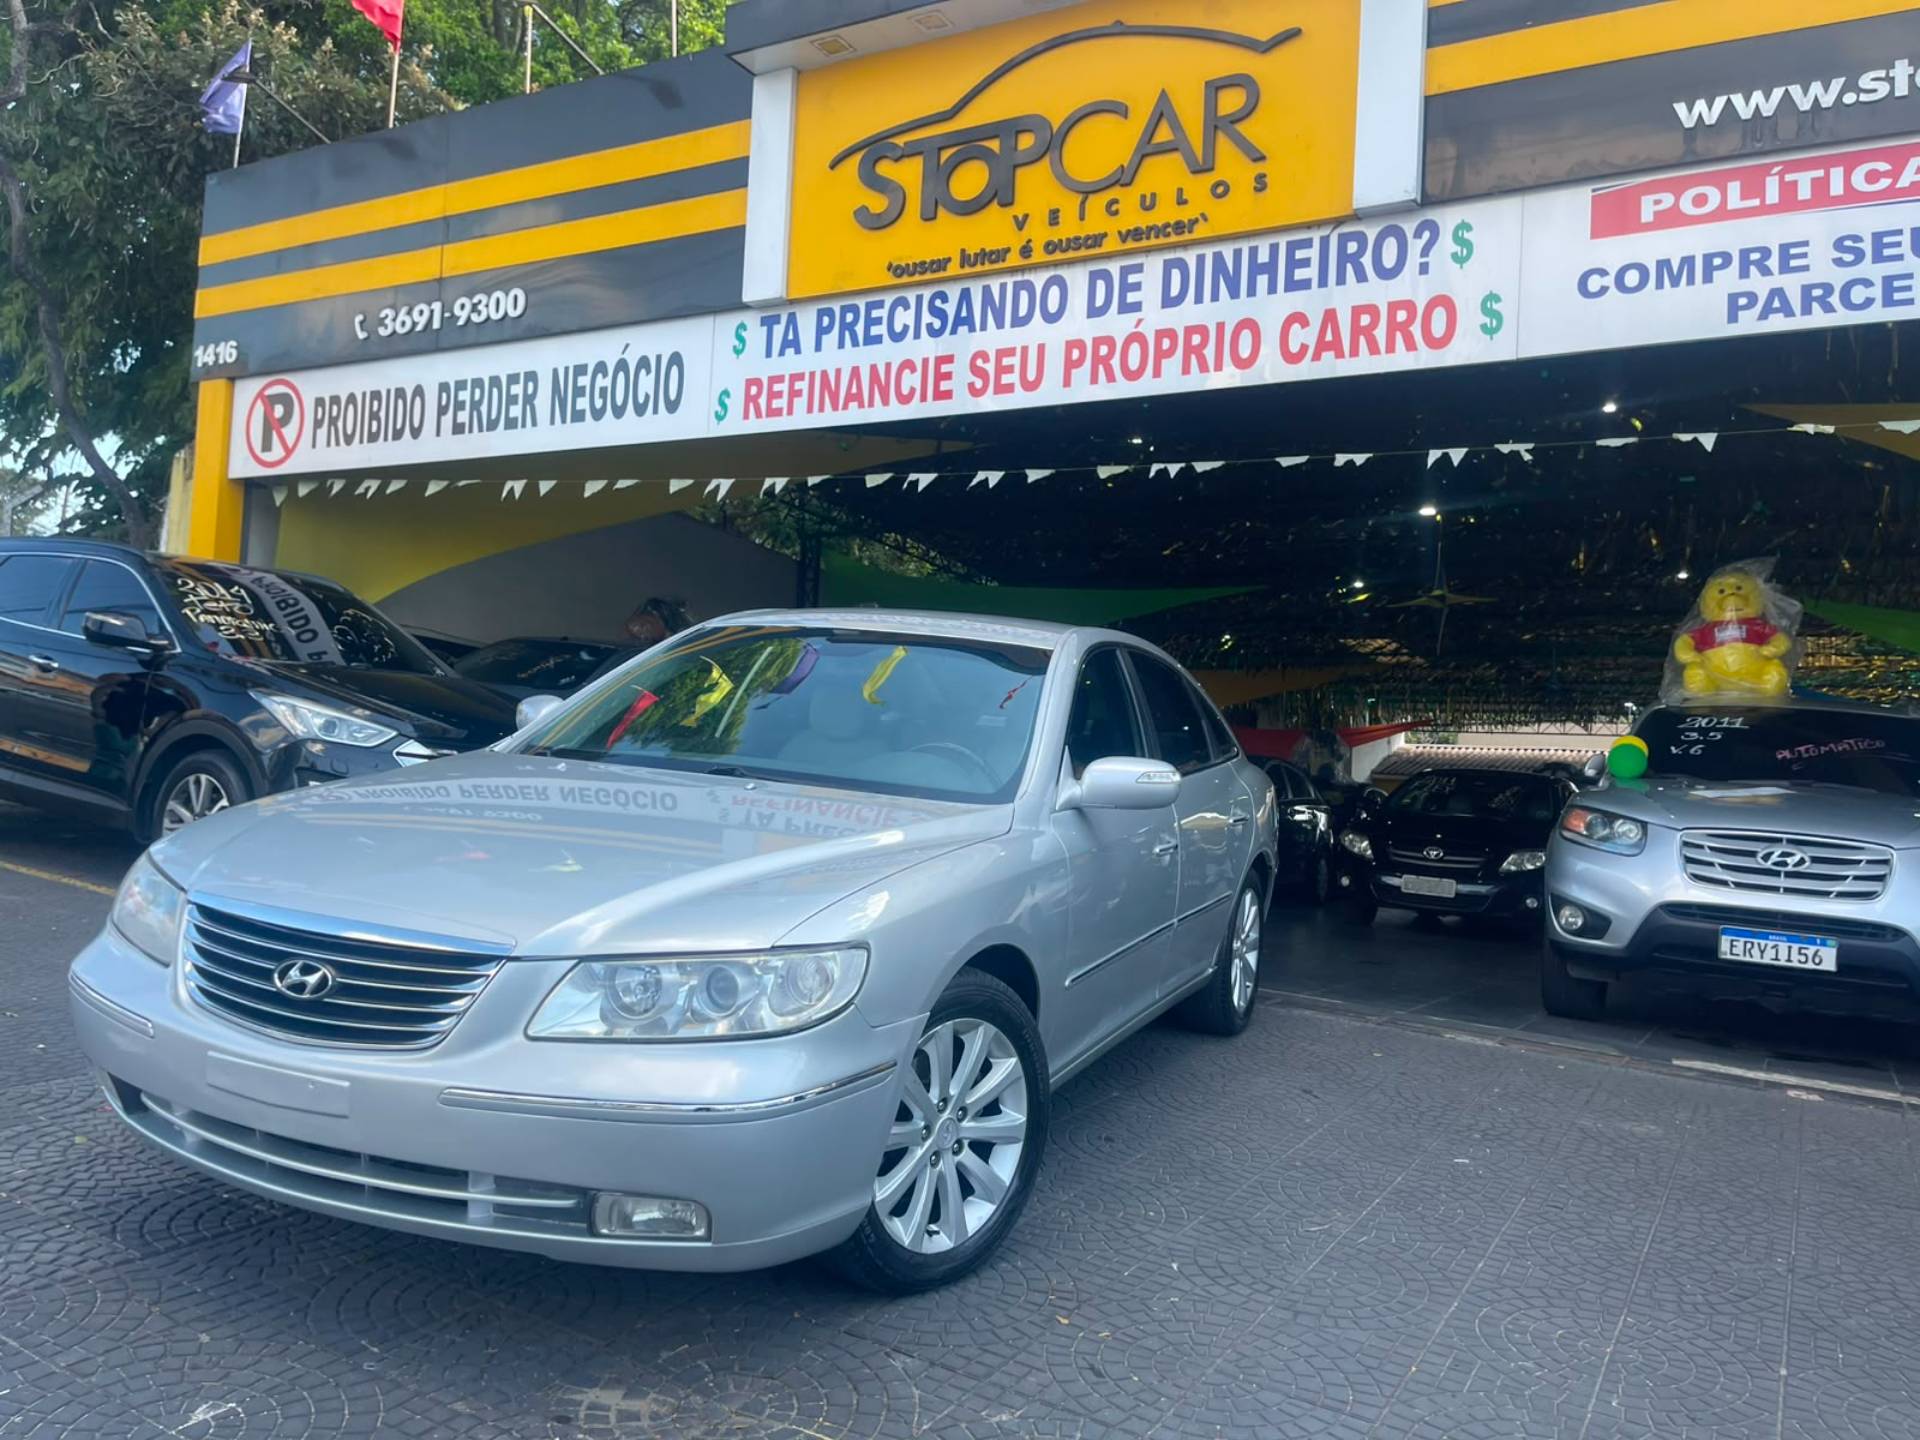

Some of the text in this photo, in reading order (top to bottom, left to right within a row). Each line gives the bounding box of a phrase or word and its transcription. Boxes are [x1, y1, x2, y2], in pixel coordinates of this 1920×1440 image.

[1672, 58, 1920, 129] www.st
[1012, 172, 1268, 232] VEÍCULOS
[959, 246, 1012, 269] lutar
[1019, 238, 1034, 259] é
[1043, 231, 1108, 256] ousar
[1577, 226, 1920, 300] COMPRE SE
[377, 287, 527, 338] 3691-9300
[760, 311, 802, 359] TA
[814, 273, 1069, 353] PRECISANDO
[1086, 263, 1145, 320] DE
[1160, 218, 1441, 310] DINHEIRO?
[1726, 272, 1915, 325] PARCE
[193, 340, 238, 368] 1416
[742, 353, 955, 421] REFINANCIE
[967, 343, 1046, 399] SEU
[1062, 317, 1262, 388] PRÓPRIO
[1279, 293, 1458, 365] CARRO
[311, 343, 685, 450] PROIBIDO PERDER NEGÓCIO
[1678, 716, 1748, 729] 2011
[1680, 731, 1723, 741] 3.5
[1728, 938, 1824, 967] ERY1I56
